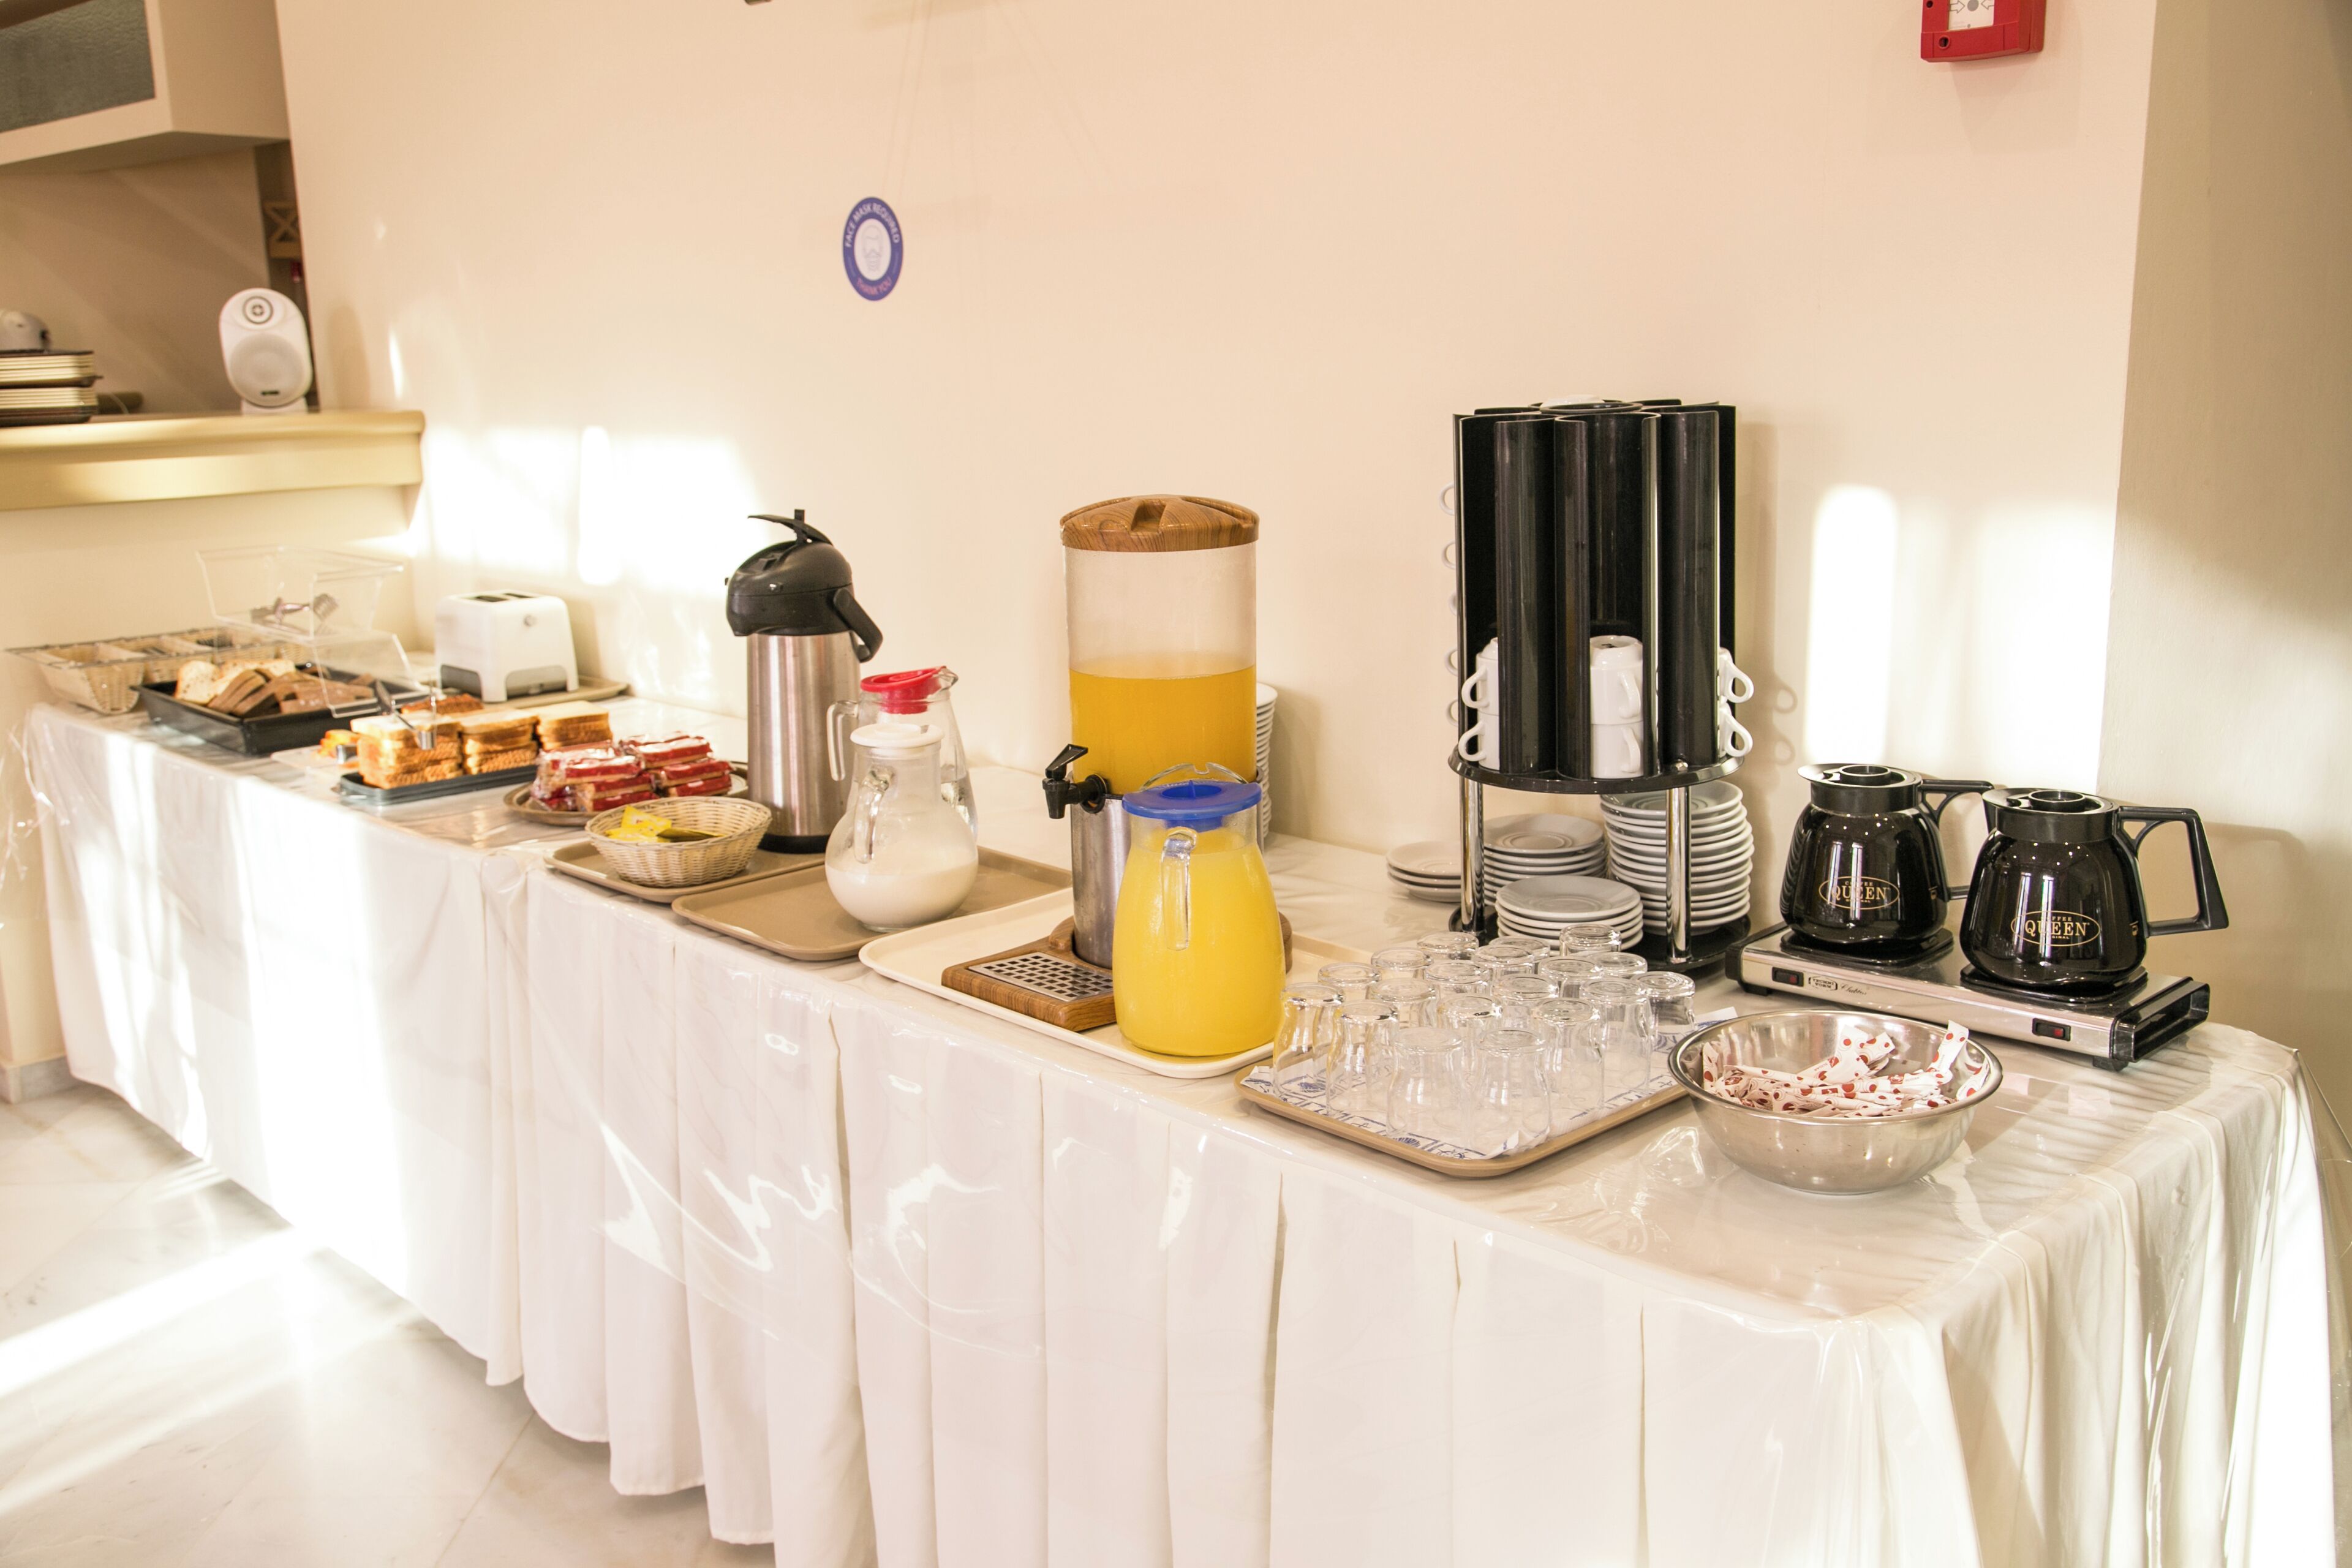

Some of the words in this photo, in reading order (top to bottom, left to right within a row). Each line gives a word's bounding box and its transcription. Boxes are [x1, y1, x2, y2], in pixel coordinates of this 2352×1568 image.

[845, 221, 856, 247] FACE
[853, 203, 872, 222] MASK
[872, 203, 900, 243] REQUIRED
[1831, 886, 1887, 900] QUEEN
[2024, 920, 2086, 937] QUEEN
